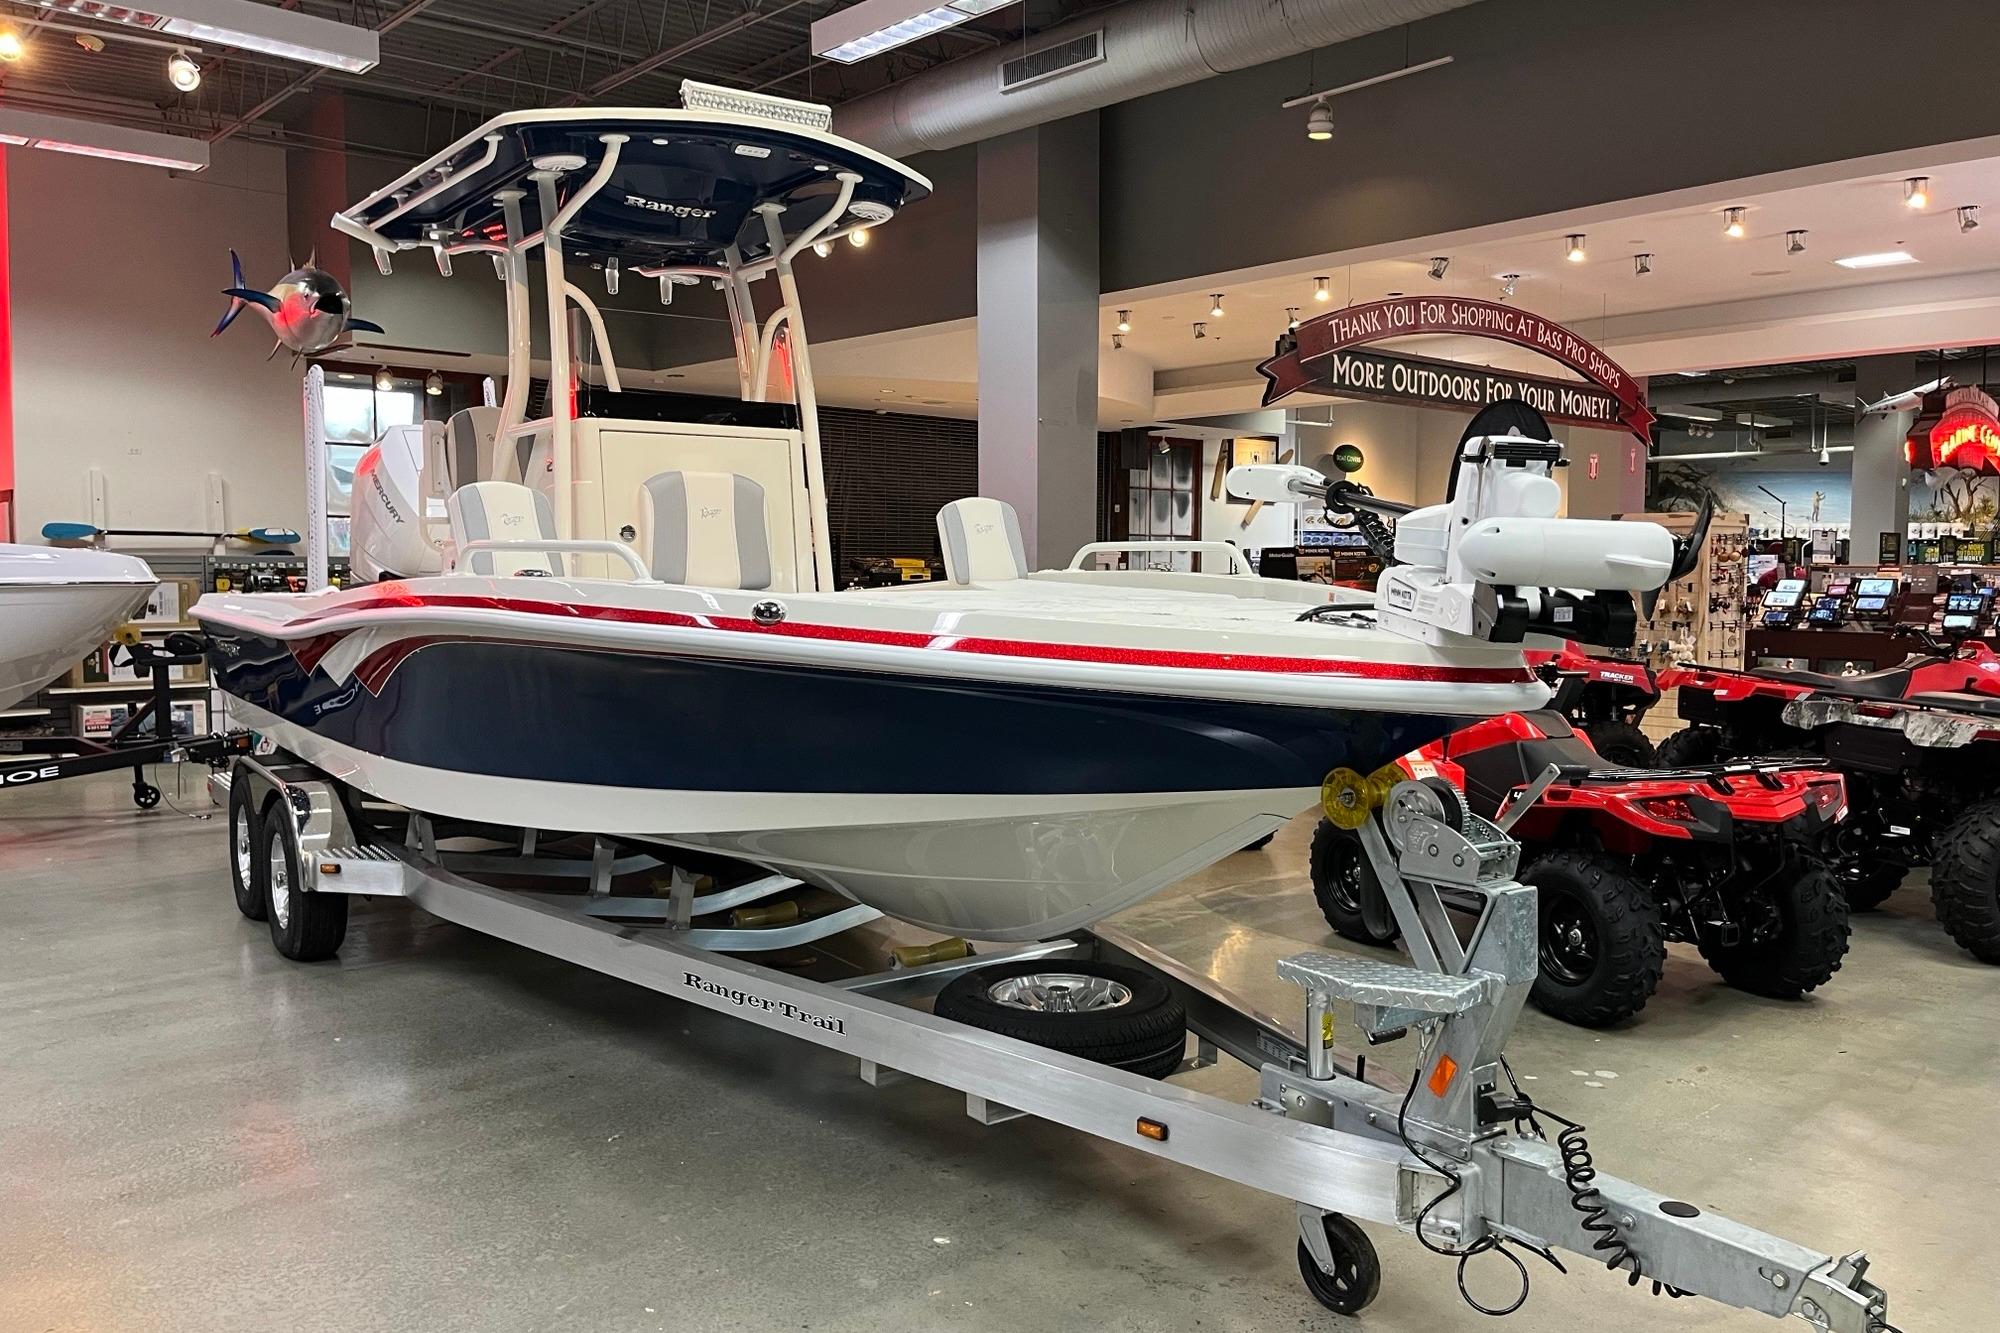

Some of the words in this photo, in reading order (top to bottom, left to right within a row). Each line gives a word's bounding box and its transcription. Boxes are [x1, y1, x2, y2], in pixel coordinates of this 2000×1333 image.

[624, 195, 717, 218] Ranger
[1328, 310, 1381, 344] THANK
[1384, 305, 1415, 328] YOU
[1420, 302, 1447, 324] FOR
[1452, 303, 1513, 332] SHOPPING
[1517, 315, 1534, 338] AT
[1538, 322, 1563, 351] BASS
[1565, 335, 1587, 364] PRO
[1589, 352, 1621, 389] SHOPS
[1332, 354, 1385, 390] MORE
[1392, 363, 1480, 402] OUTDOORS
[1486, 377, 1513, 403] FOR
[1518, 382, 1555, 412] YOUR
[1560, 388, 1610, 419] MONEY!
[370, 469, 405, 523] MERCURY
[1600, 671, 1634, 680] TRACKER
[683, 972, 775, 1012] Ranger
[778, 1001, 848, 1037] Trail
